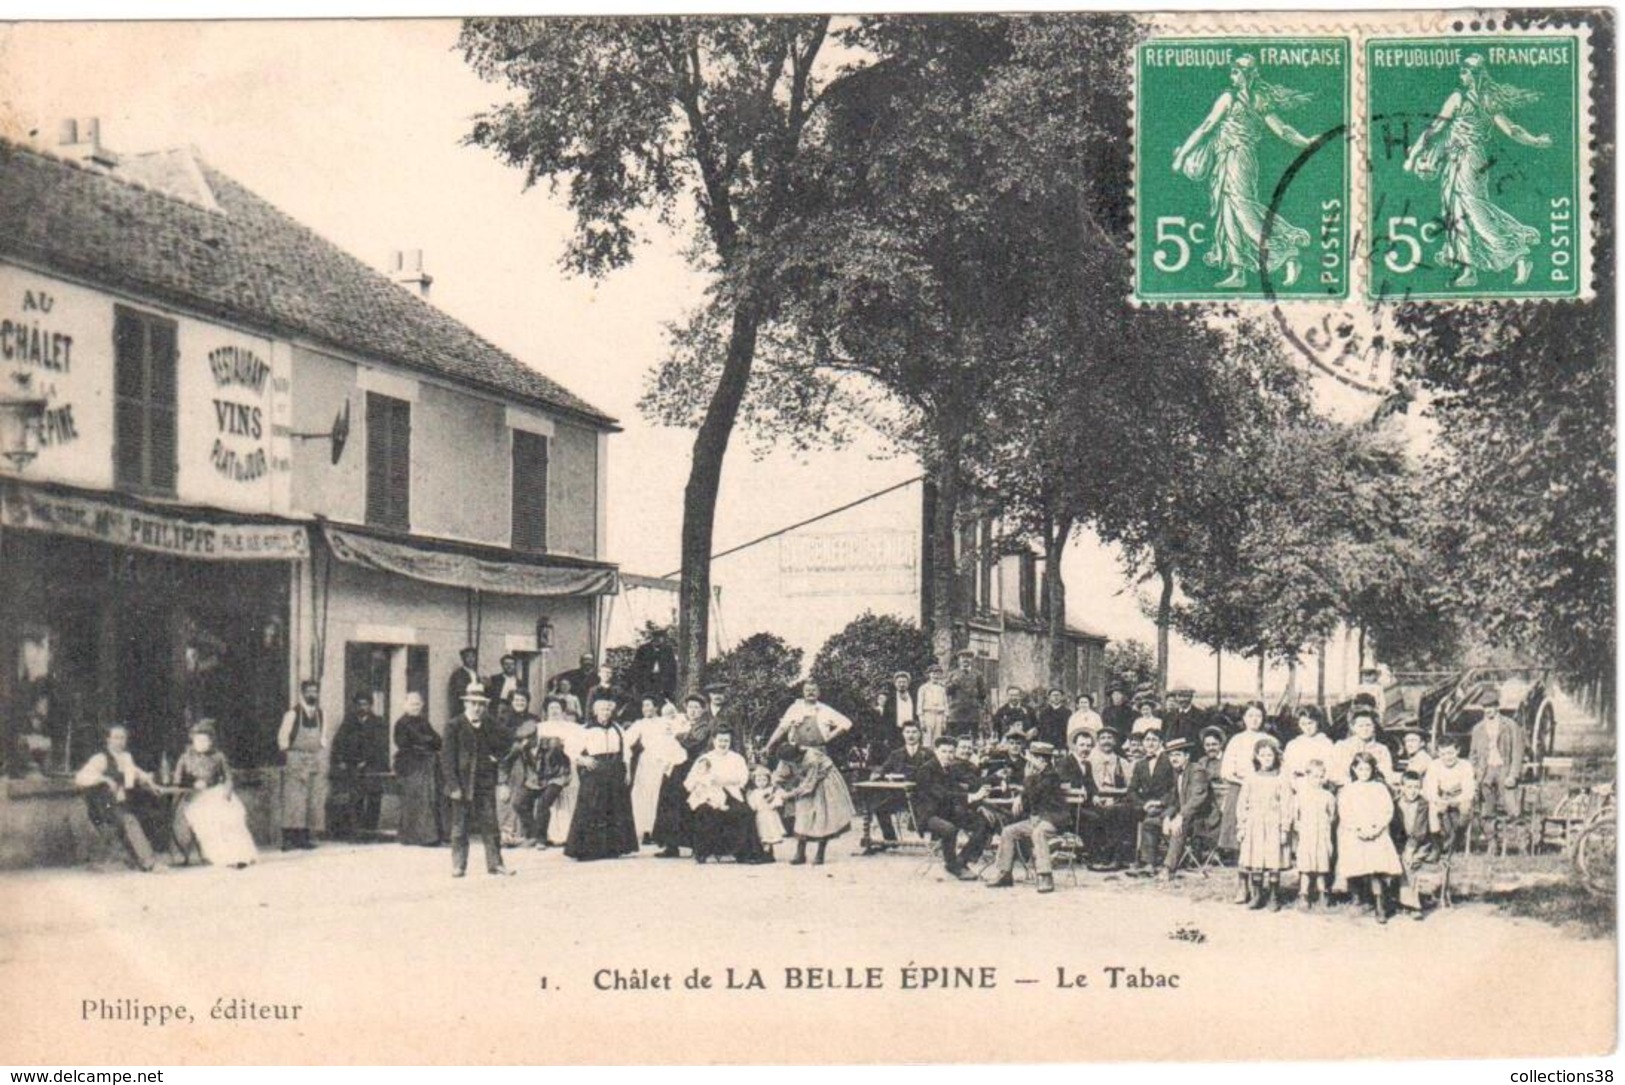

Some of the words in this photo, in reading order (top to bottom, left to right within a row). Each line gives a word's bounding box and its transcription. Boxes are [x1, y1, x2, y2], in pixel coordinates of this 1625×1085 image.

[1260, 47, 1341, 68] FRANÇAISE
[1488, 47, 1570, 67] FRANÇAISE
[1551, 197, 1570, 281] POSTES
[23, 290, 54, 314] AU
[212, 398, 263, 441] VINS
[130, 517, 215, 554] PHILIPPE
[593, 966, 671, 991] Châlet
[684, 967, 713, 991] de
[726, 967, 766, 991] LA
[785, 967, 884, 991] BELLE
[900, 961, 998, 991] ÉPINE
[1056, 967, 1088, 990] Le
[1103, 967, 1182, 991] Tabac
[81, 998, 195, 1026] Philippe,
[210, 997, 303, 1020] éditeur
